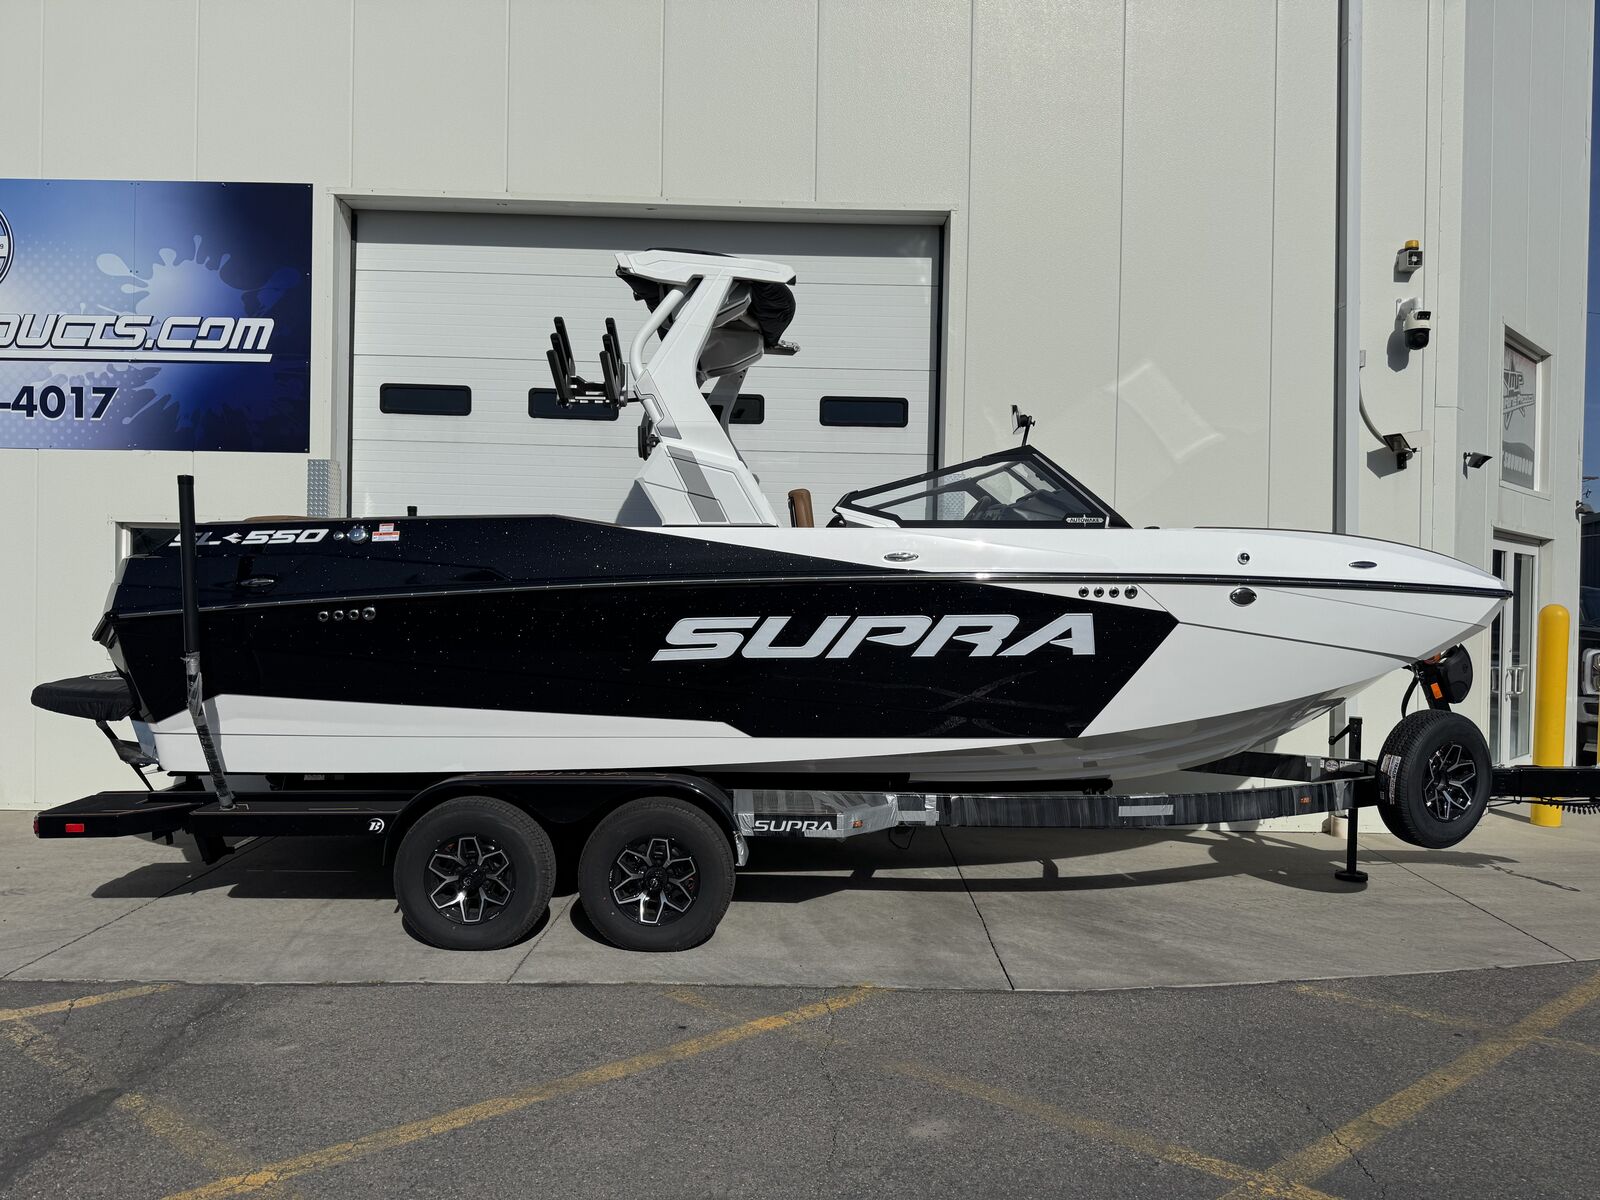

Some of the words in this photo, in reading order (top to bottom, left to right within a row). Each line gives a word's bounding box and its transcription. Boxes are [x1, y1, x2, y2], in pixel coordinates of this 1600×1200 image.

[0, 385, 120, 421] -4017
[241, 528, 329, 545] 550
[651, 613, 1096, 661] SUPRA
[753, 820, 834, 832] SUPRA
